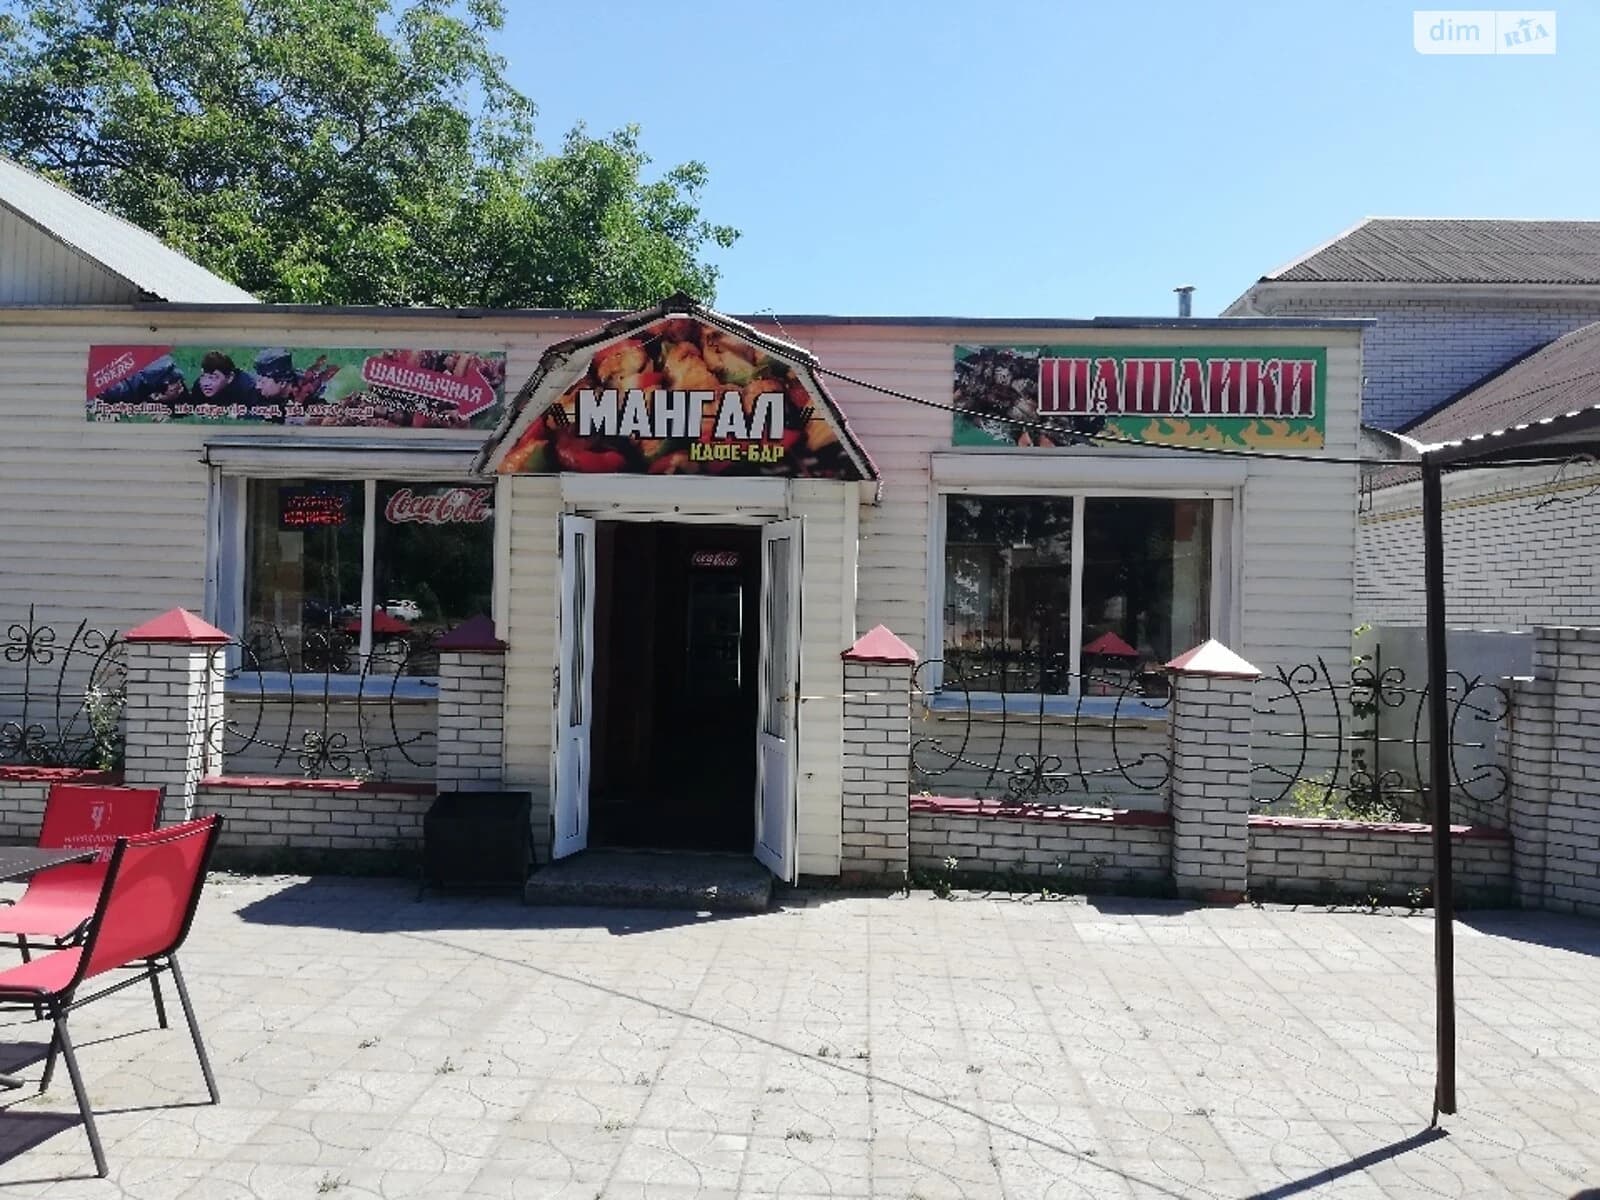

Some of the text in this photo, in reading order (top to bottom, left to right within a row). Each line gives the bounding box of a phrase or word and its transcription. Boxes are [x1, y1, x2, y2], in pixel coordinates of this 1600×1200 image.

[370, 361, 482, 404] ШАШЛЫЧНАЯ
[1037, 357, 1317, 419] ШАШЛИКИ
[579, 389, 785, 440] МАНГАЛ
[690, 442, 785, 463] КАФЕ-БАР
